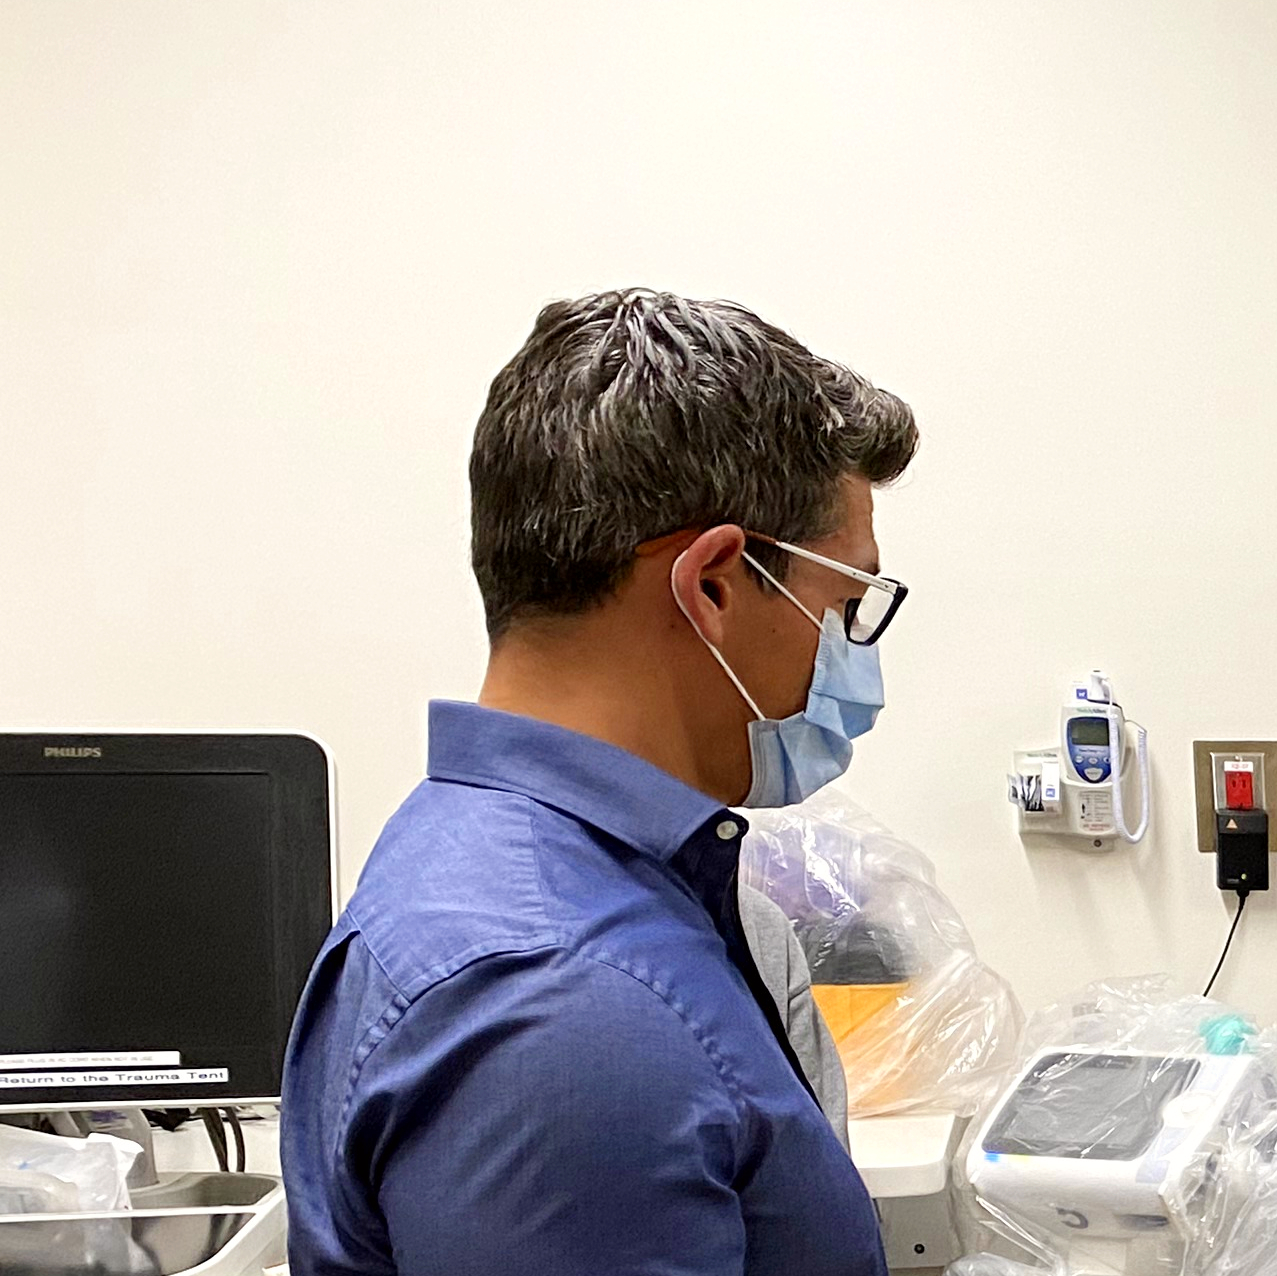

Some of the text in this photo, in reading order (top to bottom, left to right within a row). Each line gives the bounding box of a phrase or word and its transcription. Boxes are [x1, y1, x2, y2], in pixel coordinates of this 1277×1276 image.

[44, 747, 102, 758] PHILIPS
[0, 1071, 224, 1084] Return to the Trauma Tent
